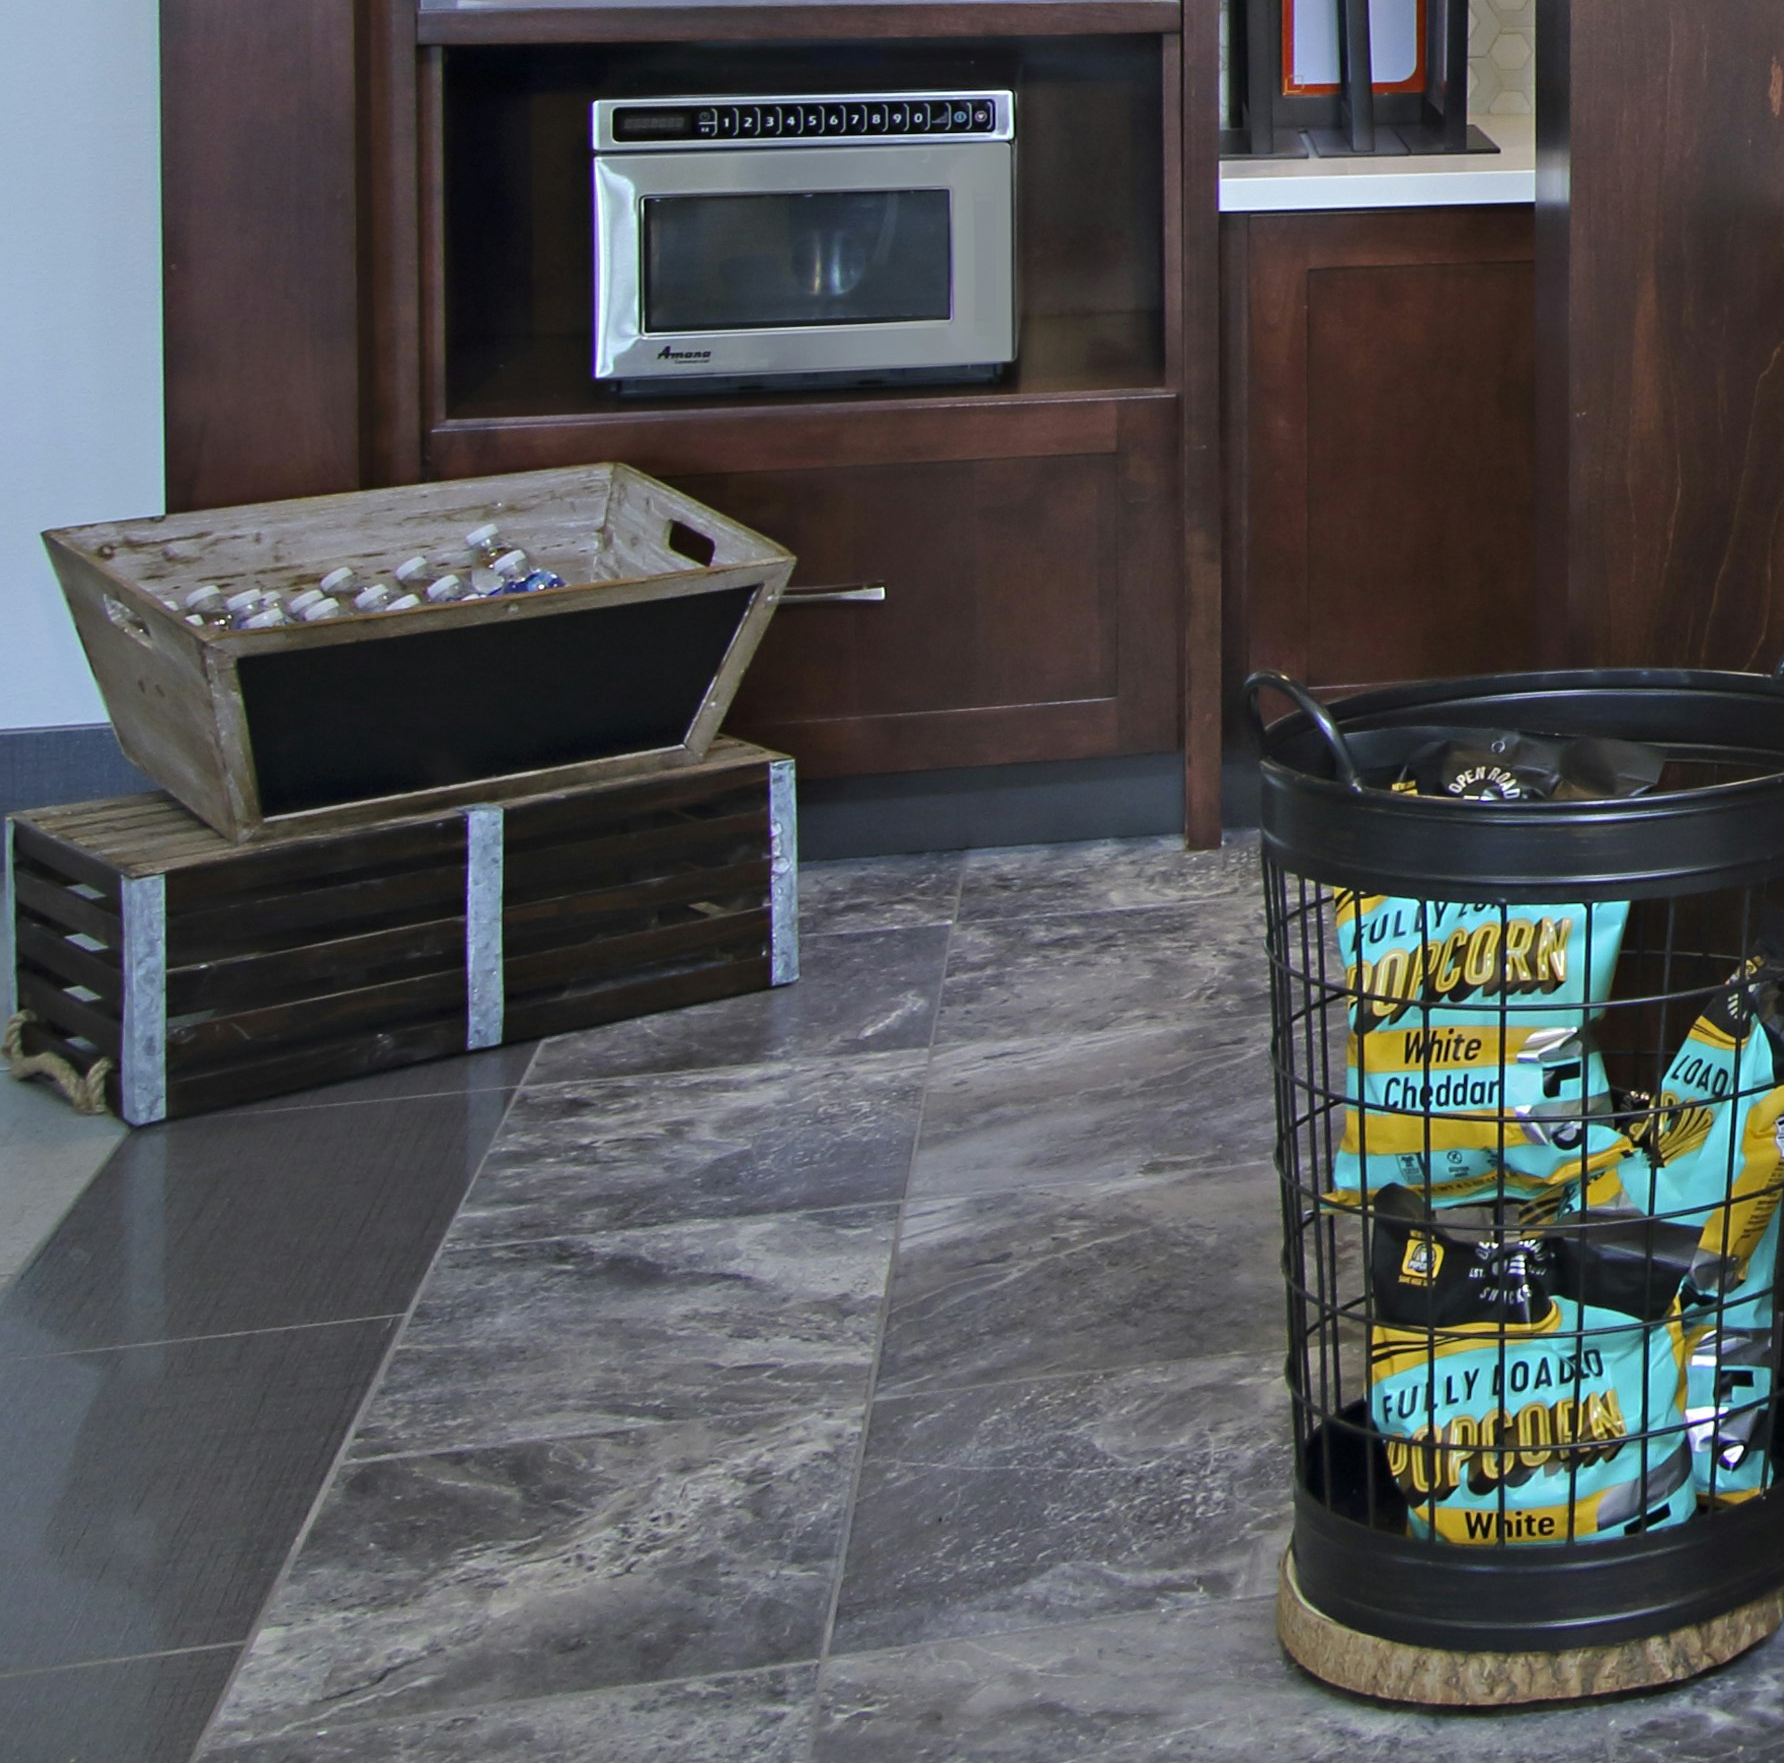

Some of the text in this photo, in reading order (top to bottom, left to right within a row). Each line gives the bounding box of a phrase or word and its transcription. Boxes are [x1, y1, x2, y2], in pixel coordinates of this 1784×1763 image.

[743, 116, 753, 128] 2
[765, 116, 775, 128] 3
[786, 116, 796, 127] 4
[807, 115, 817, 127] 5
[829, 114, 839, 126] 6
[913, 112, 924, 124] 0
[656, 345, 711, 361] Amana
[1347, 917, 1574, 1021] POPCORN
[1403, 1029, 1482, 1065] White
[1383, 1074, 1500, 1112] Cheddar
[1382, 1347, 1605, 1423] FULLY LOADED
[1386, 1388, 1628, 1496] POPCORN
[1464, 1510, 1555, 1541] White
